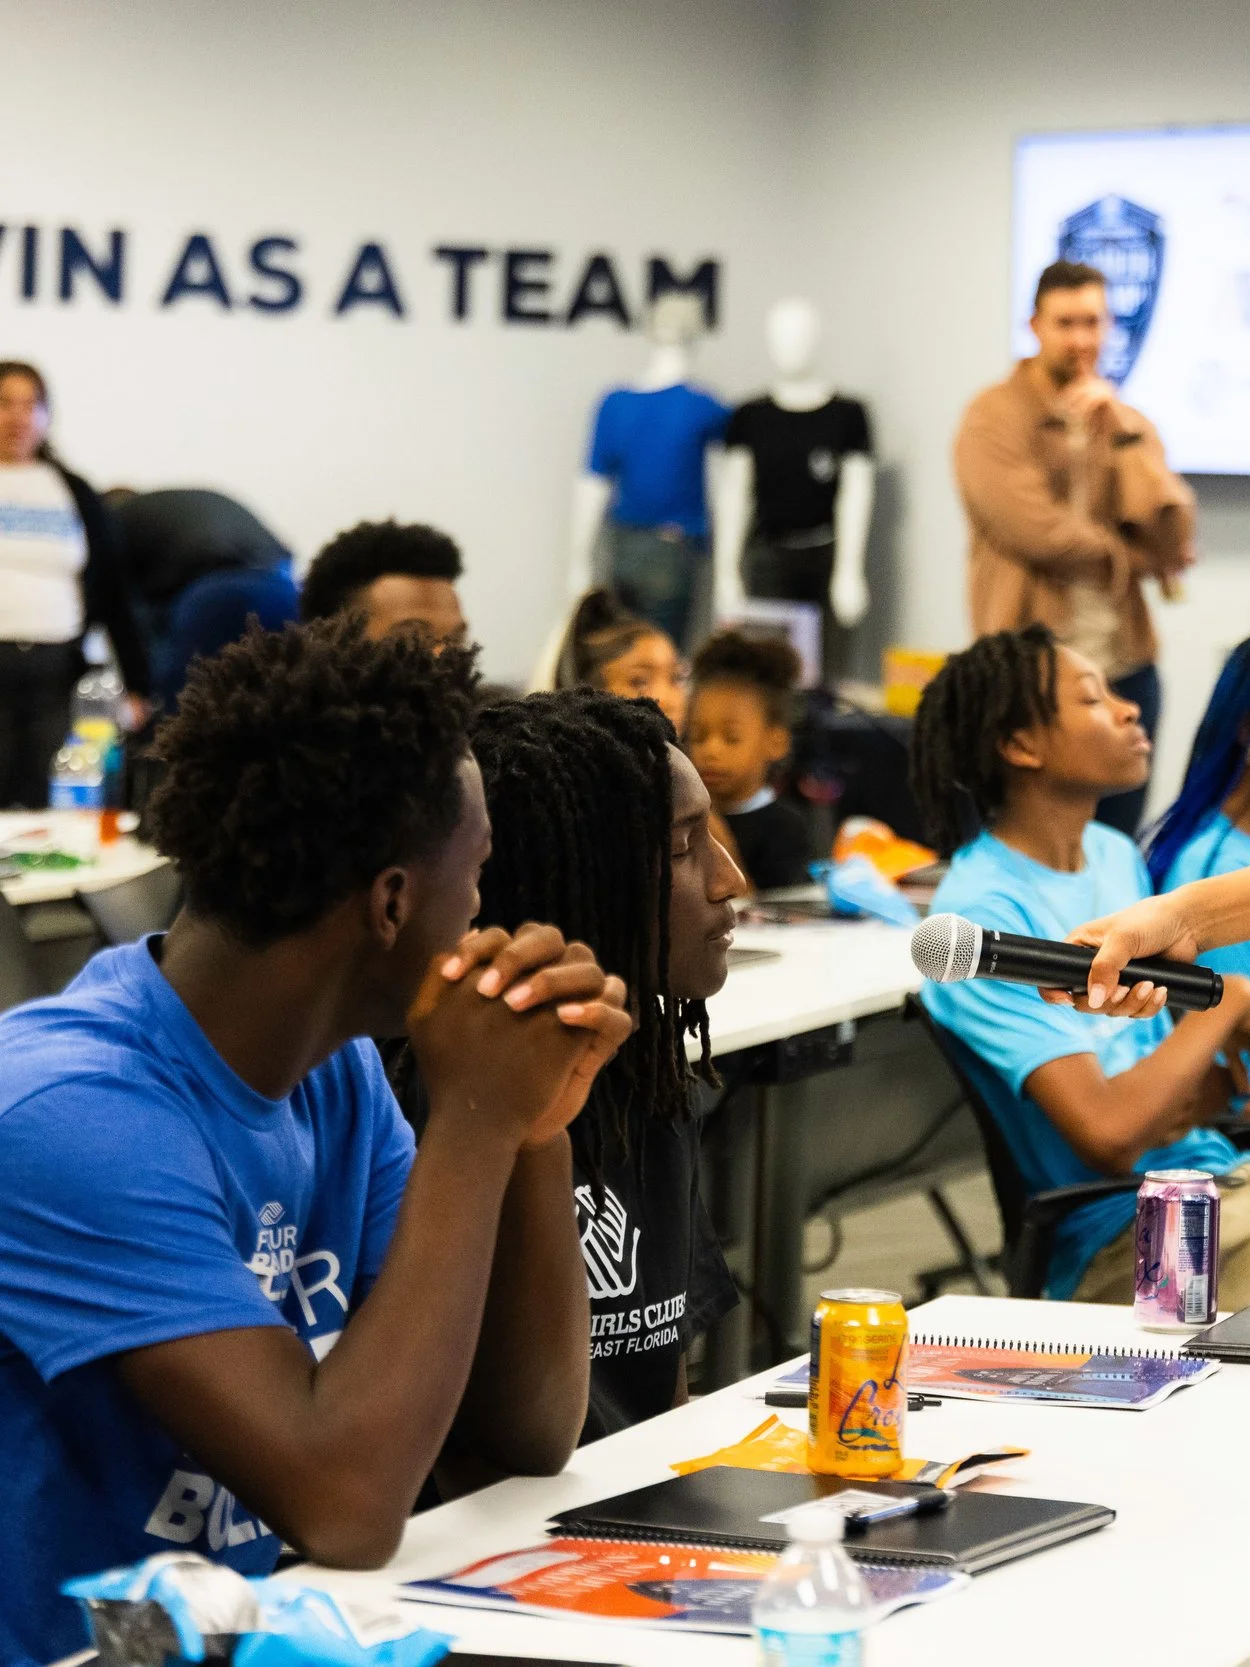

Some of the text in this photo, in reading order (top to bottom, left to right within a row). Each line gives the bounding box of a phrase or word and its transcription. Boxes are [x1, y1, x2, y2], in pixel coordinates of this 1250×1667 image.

[0, 223, 722, 333] IN AS A TEAM
[590, 1290, 687, 1338] IRLS CLUB
[626, 1325, 679, 1355] FLORIDA
